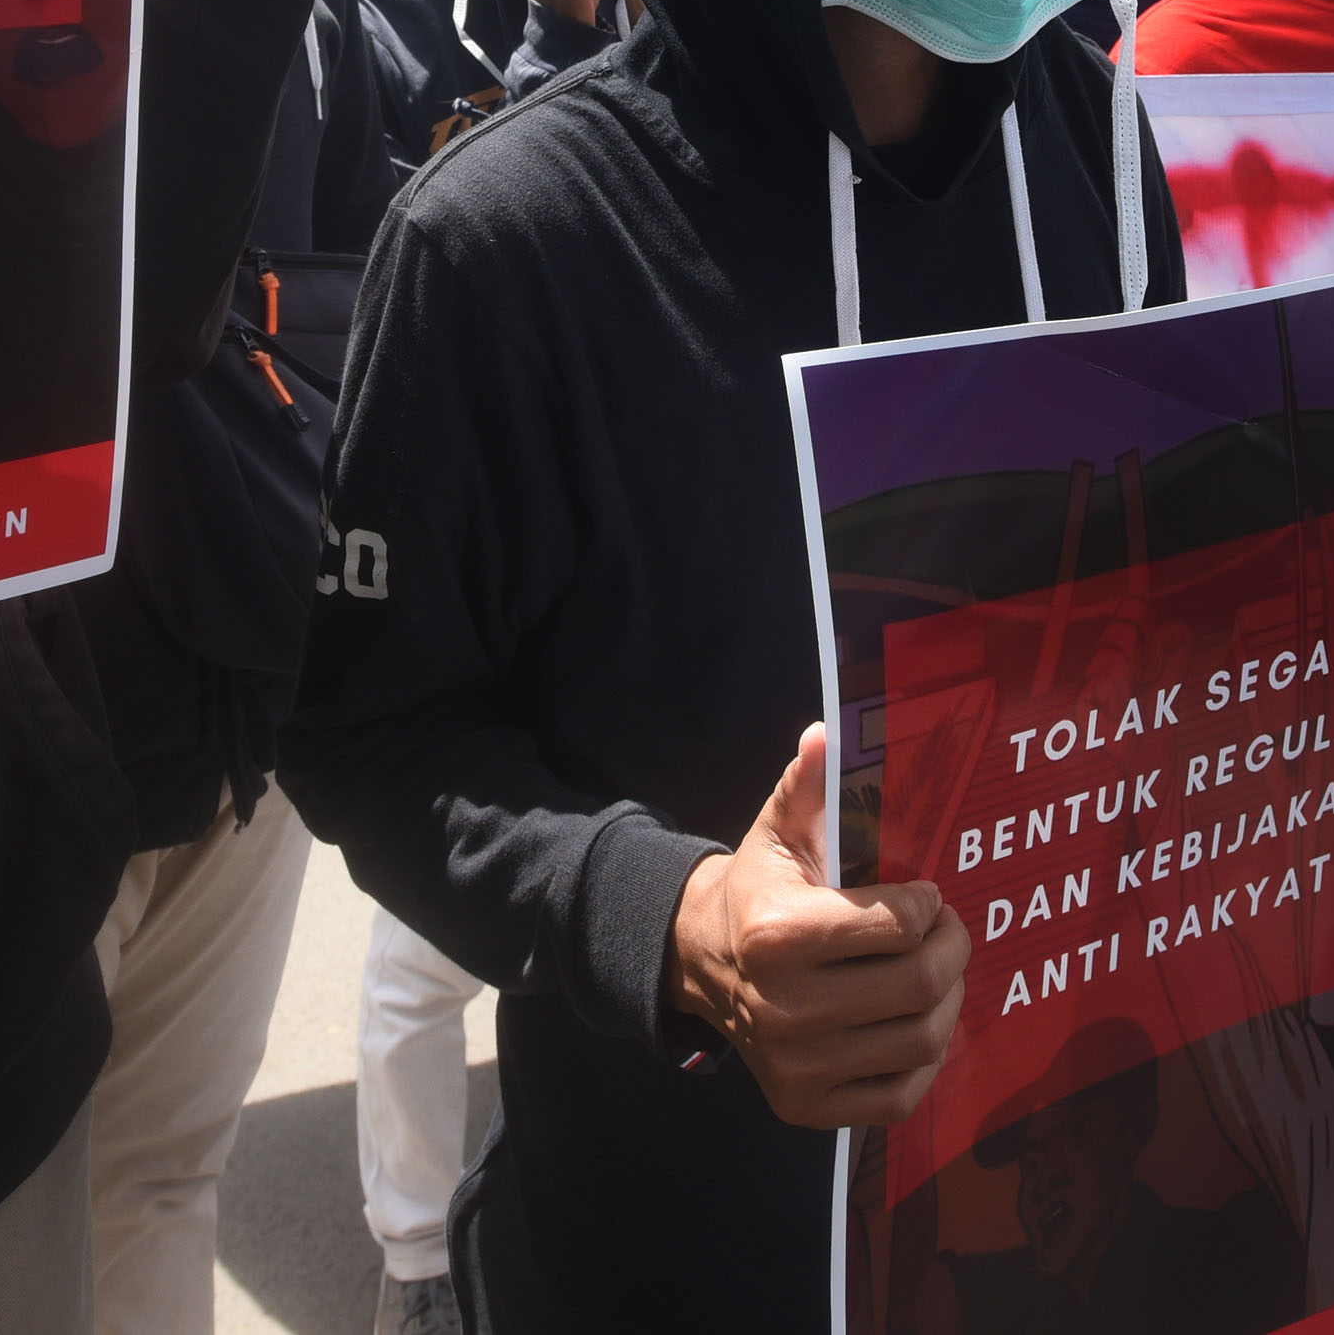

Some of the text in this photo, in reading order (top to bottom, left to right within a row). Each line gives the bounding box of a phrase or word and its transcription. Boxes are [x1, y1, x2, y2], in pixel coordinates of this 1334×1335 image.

[1010, 684, 1181, 772] TOLAK
[958, 769, 1160, 872] BENTUK
[986, 868, 1090, 941] DAN
[1002, 854, 1330, 1015] ANTI RAKYAT
